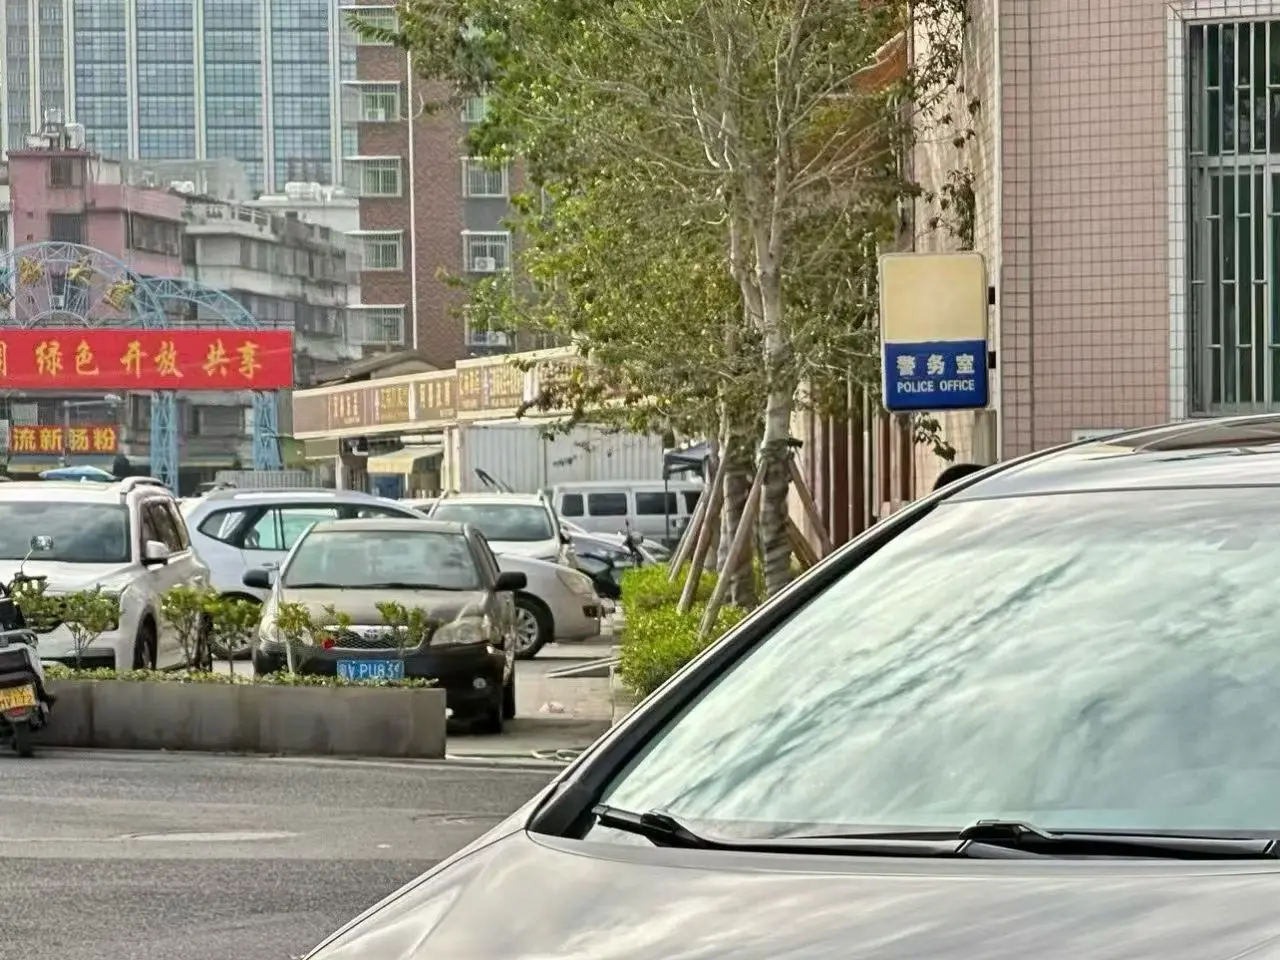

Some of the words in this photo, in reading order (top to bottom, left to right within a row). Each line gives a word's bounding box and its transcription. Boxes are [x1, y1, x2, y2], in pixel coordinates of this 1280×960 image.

[35, 339, 99, 377] 绿色
[120, 340, 183, 378] 开放
[202, 339, 262, 378] 共享
[896, 354, 975, 375] 警务室
[896, 381, 934, 393] POLICE
[939, 380, 975, 392] OFFICE
